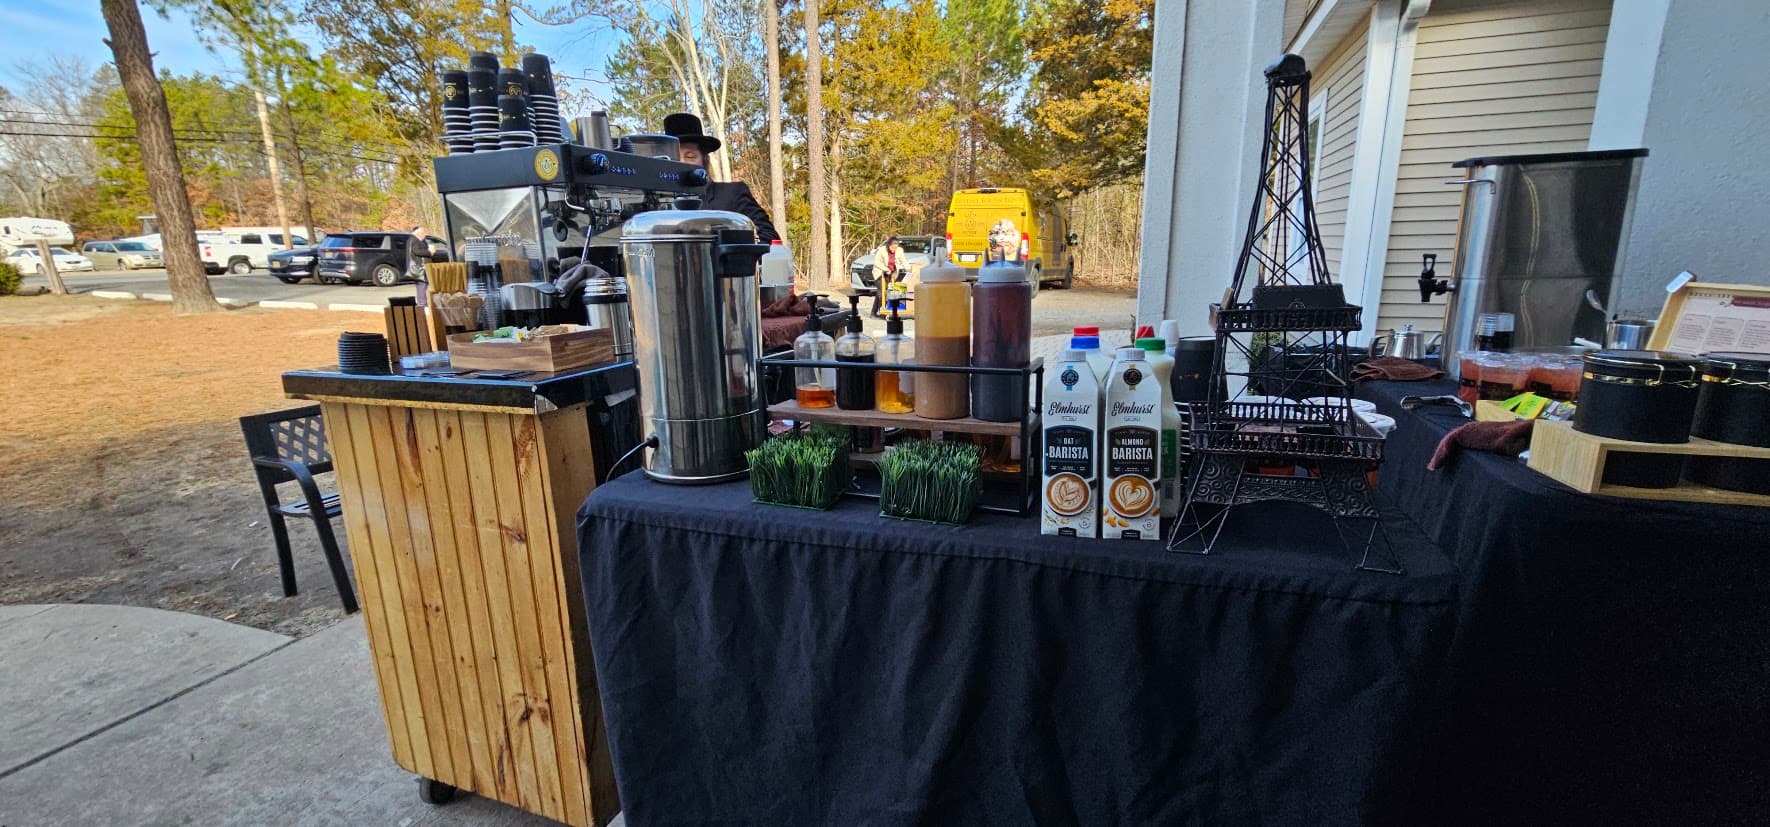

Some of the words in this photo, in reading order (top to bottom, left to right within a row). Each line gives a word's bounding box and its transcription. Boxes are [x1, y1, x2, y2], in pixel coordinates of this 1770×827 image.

[1048, 401, 1091, 416] Elmhurst
[1112, 401, 1155, 417] Elmhurst
[1063, 437, 1075, 445] OAT
[1121, 438, 1144, 446] ALMOND
[1049, 446, 1089, 460] BARISTA
[1112, 447, 1153, 460] BARISTA
